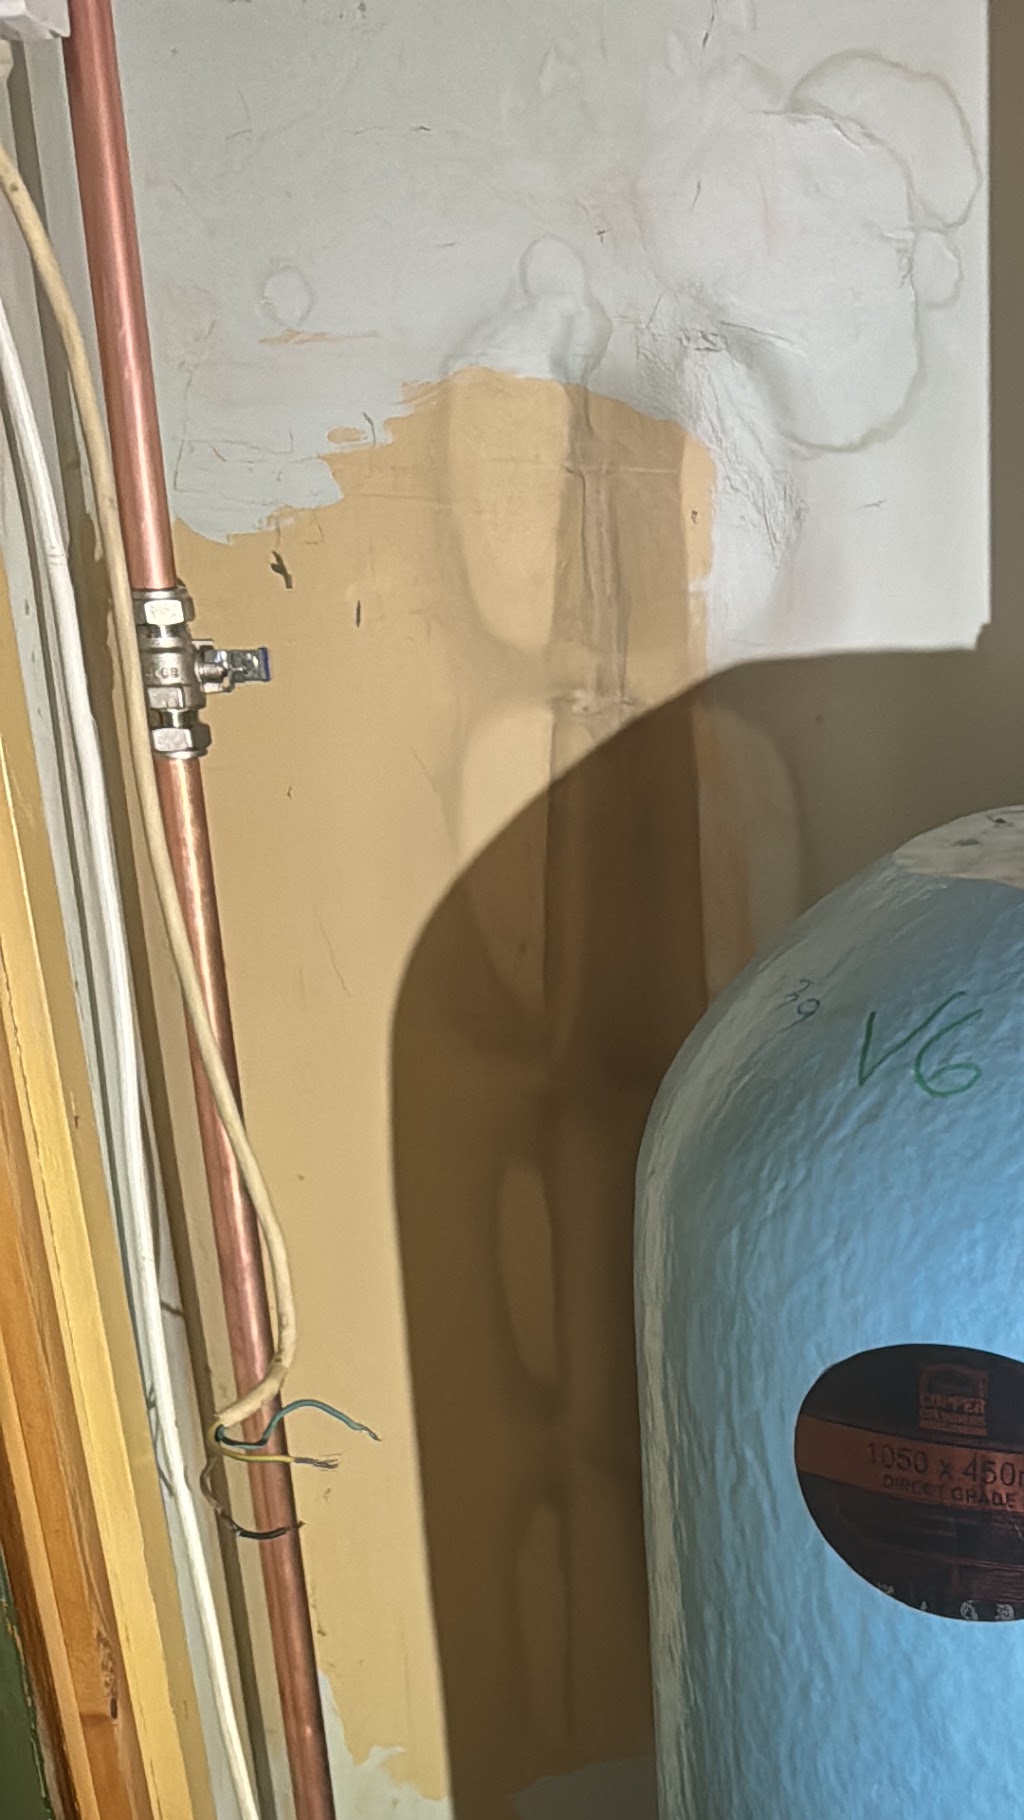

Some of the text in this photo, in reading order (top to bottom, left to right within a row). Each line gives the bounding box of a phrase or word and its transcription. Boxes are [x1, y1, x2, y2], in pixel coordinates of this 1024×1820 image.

[864, 1441, 928, 1474] 1050
[883, 1474, 944, 1495] DIRECT
[950, 1486, 1016, 1509] GRADE
